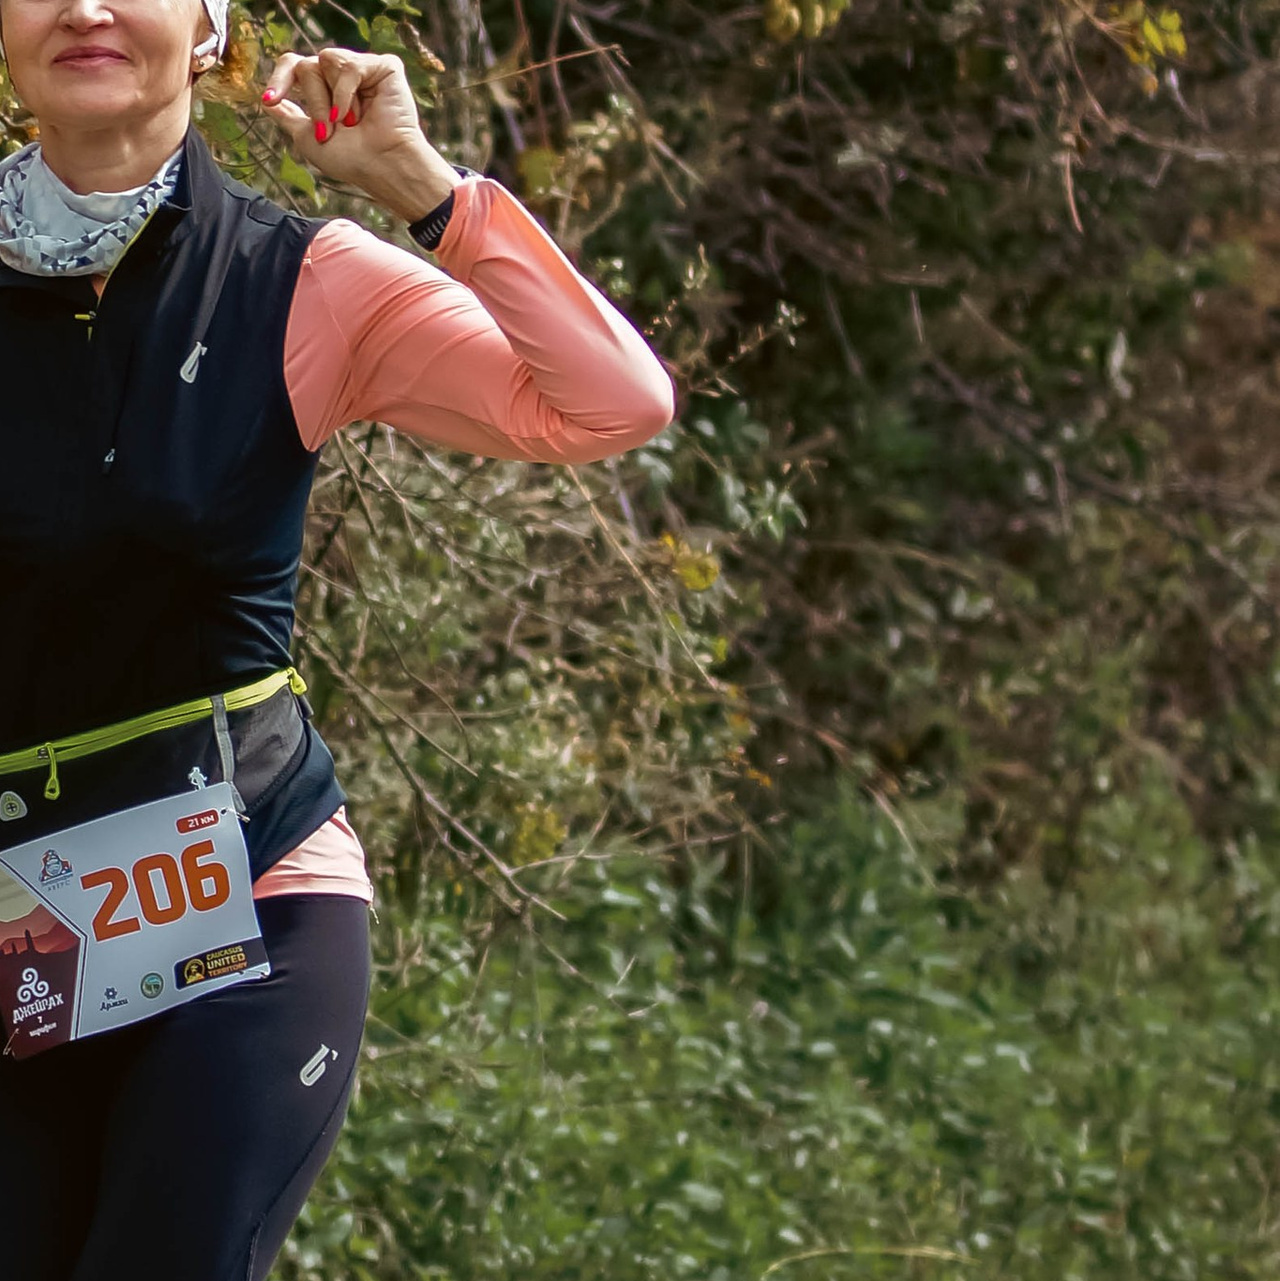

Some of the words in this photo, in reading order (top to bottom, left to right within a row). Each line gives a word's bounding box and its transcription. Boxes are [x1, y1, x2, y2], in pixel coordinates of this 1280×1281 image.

[187, 817, 199, 828] 21
[80, 839, 231, 942] 206
[206, 945, 244, 961] CAUCASUS
[206, 952, 246, 970] UNITED
[207, 961, 248, 977] TERRITORY
